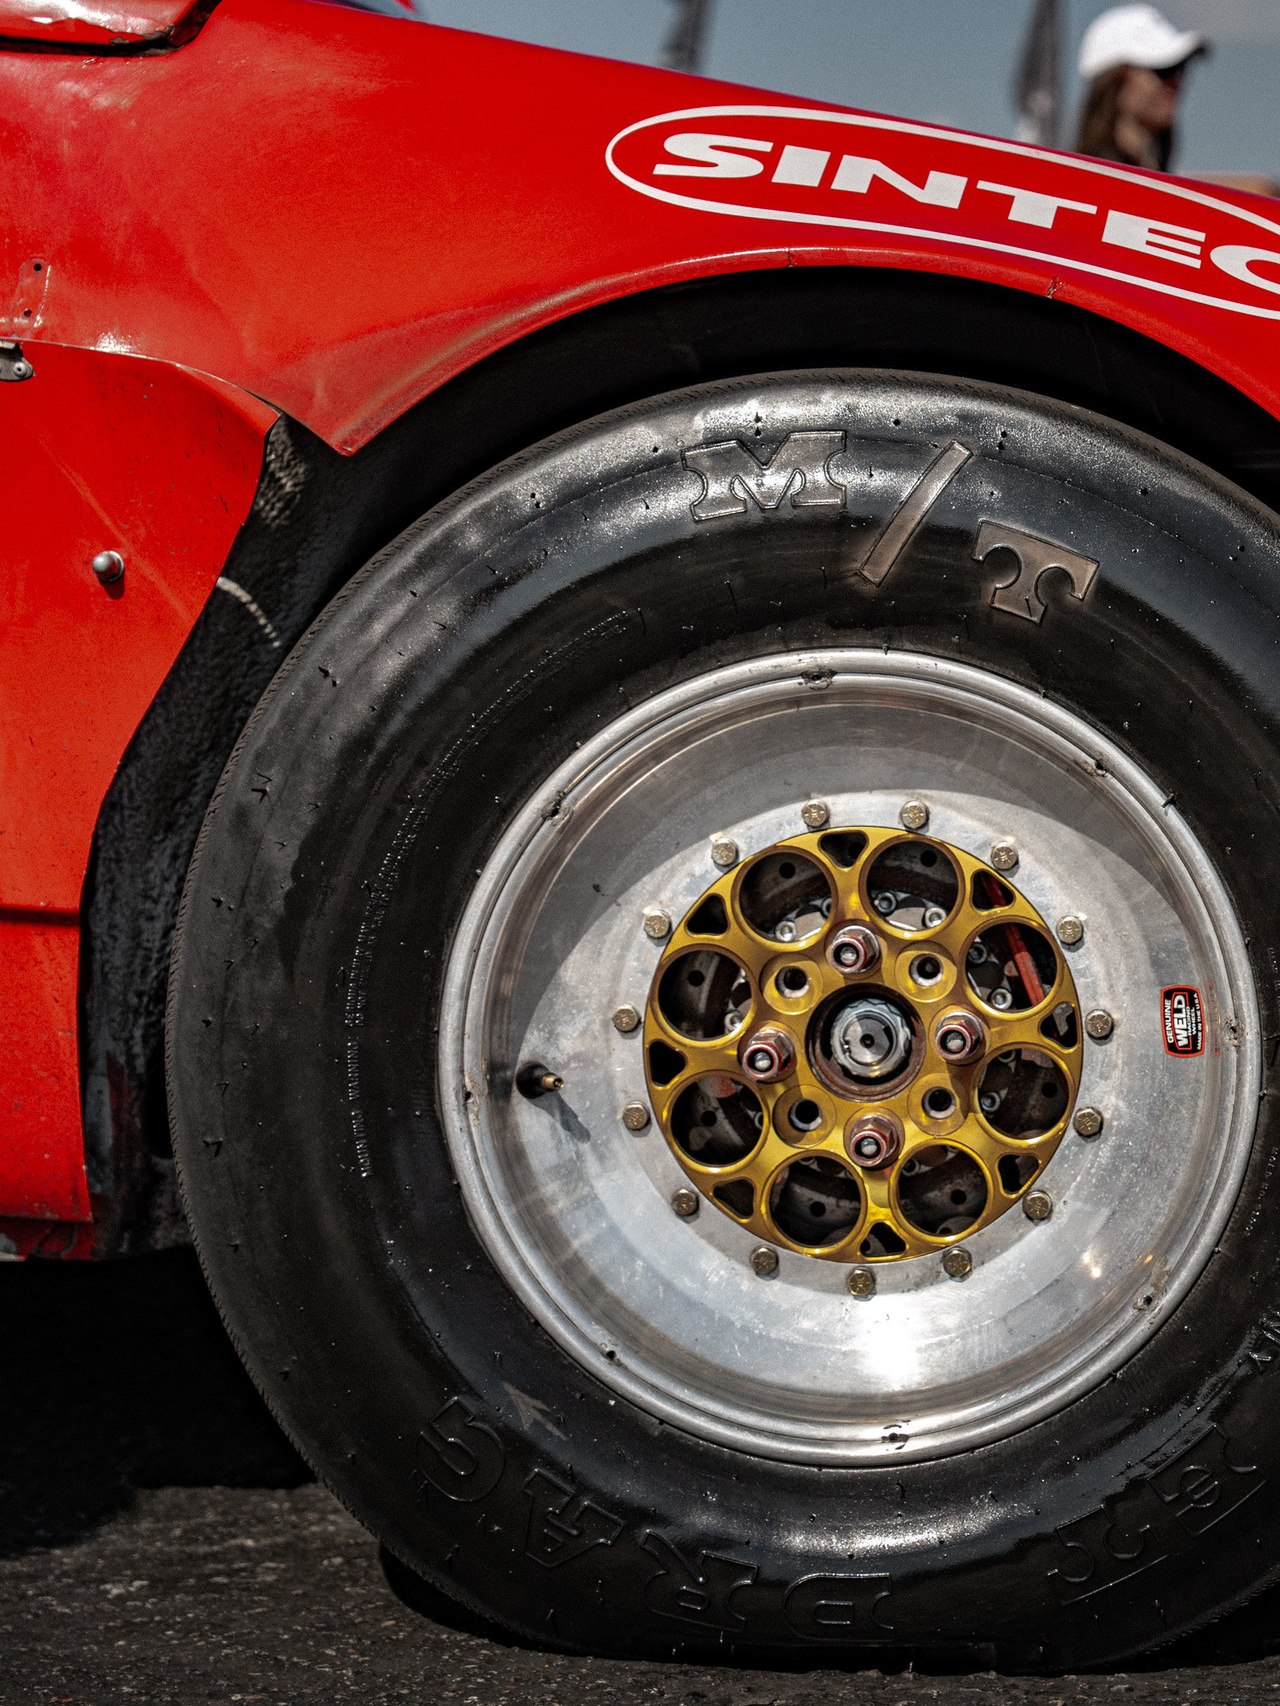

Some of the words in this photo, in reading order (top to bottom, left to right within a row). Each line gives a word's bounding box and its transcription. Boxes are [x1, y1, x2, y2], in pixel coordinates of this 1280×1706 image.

[681, 429, 1100, 625] M/T
[1164, 999, 1174, 1044] GENUINE
[1174, 994, 1189, 1047] WELD
[414, 1394, 894, 1642] DRAG
